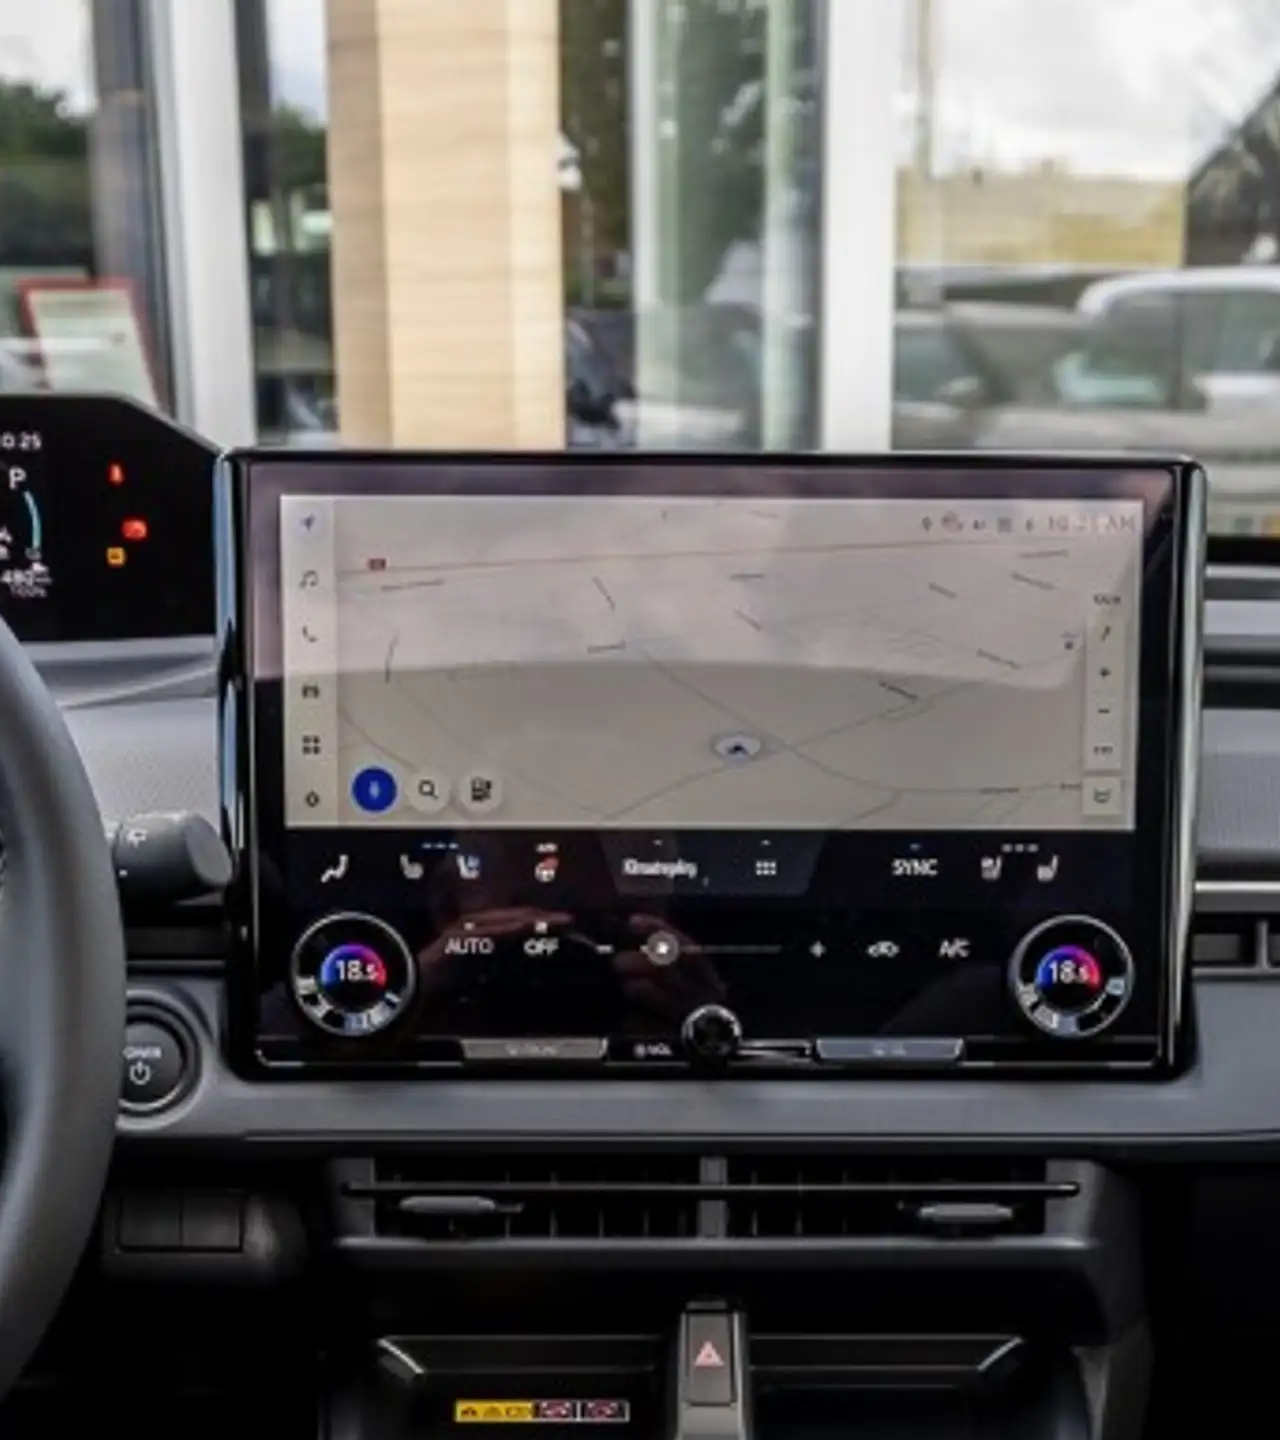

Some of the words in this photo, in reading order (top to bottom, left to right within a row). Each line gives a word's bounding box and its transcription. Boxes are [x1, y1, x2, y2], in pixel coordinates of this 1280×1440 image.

[9, 466, 27, 490] P
[892, 858, 938, 876] SYNC
[445, 938, 494, 954] AUTO
[524, 938, 560, 955] OFF
